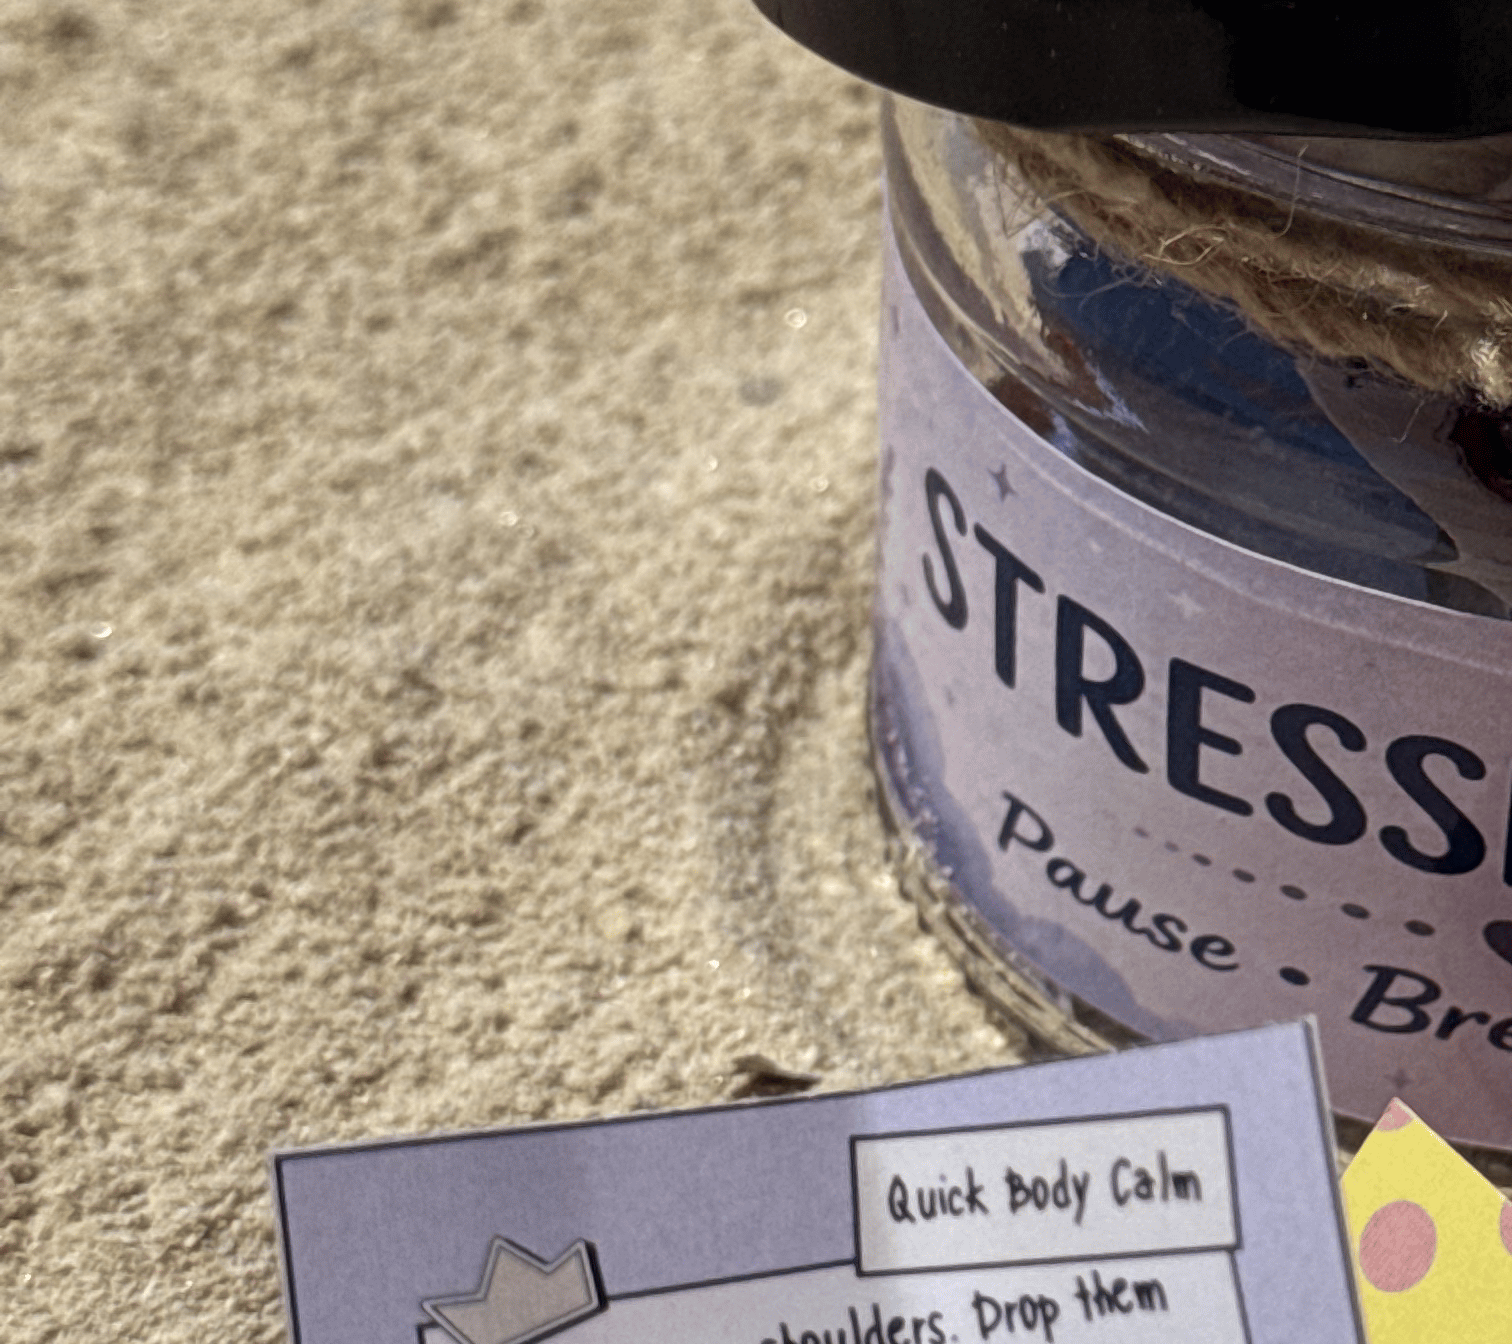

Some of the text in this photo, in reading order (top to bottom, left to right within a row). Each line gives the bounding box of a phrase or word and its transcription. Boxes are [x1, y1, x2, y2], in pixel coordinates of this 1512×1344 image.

[996, 791, 1240, 973] Pause
[887, 1150, 1203, 1224] Quick Body Calm
[972, 1290, 1060, 1343] Drop
[1074, 1270, 1169, 1320] them
